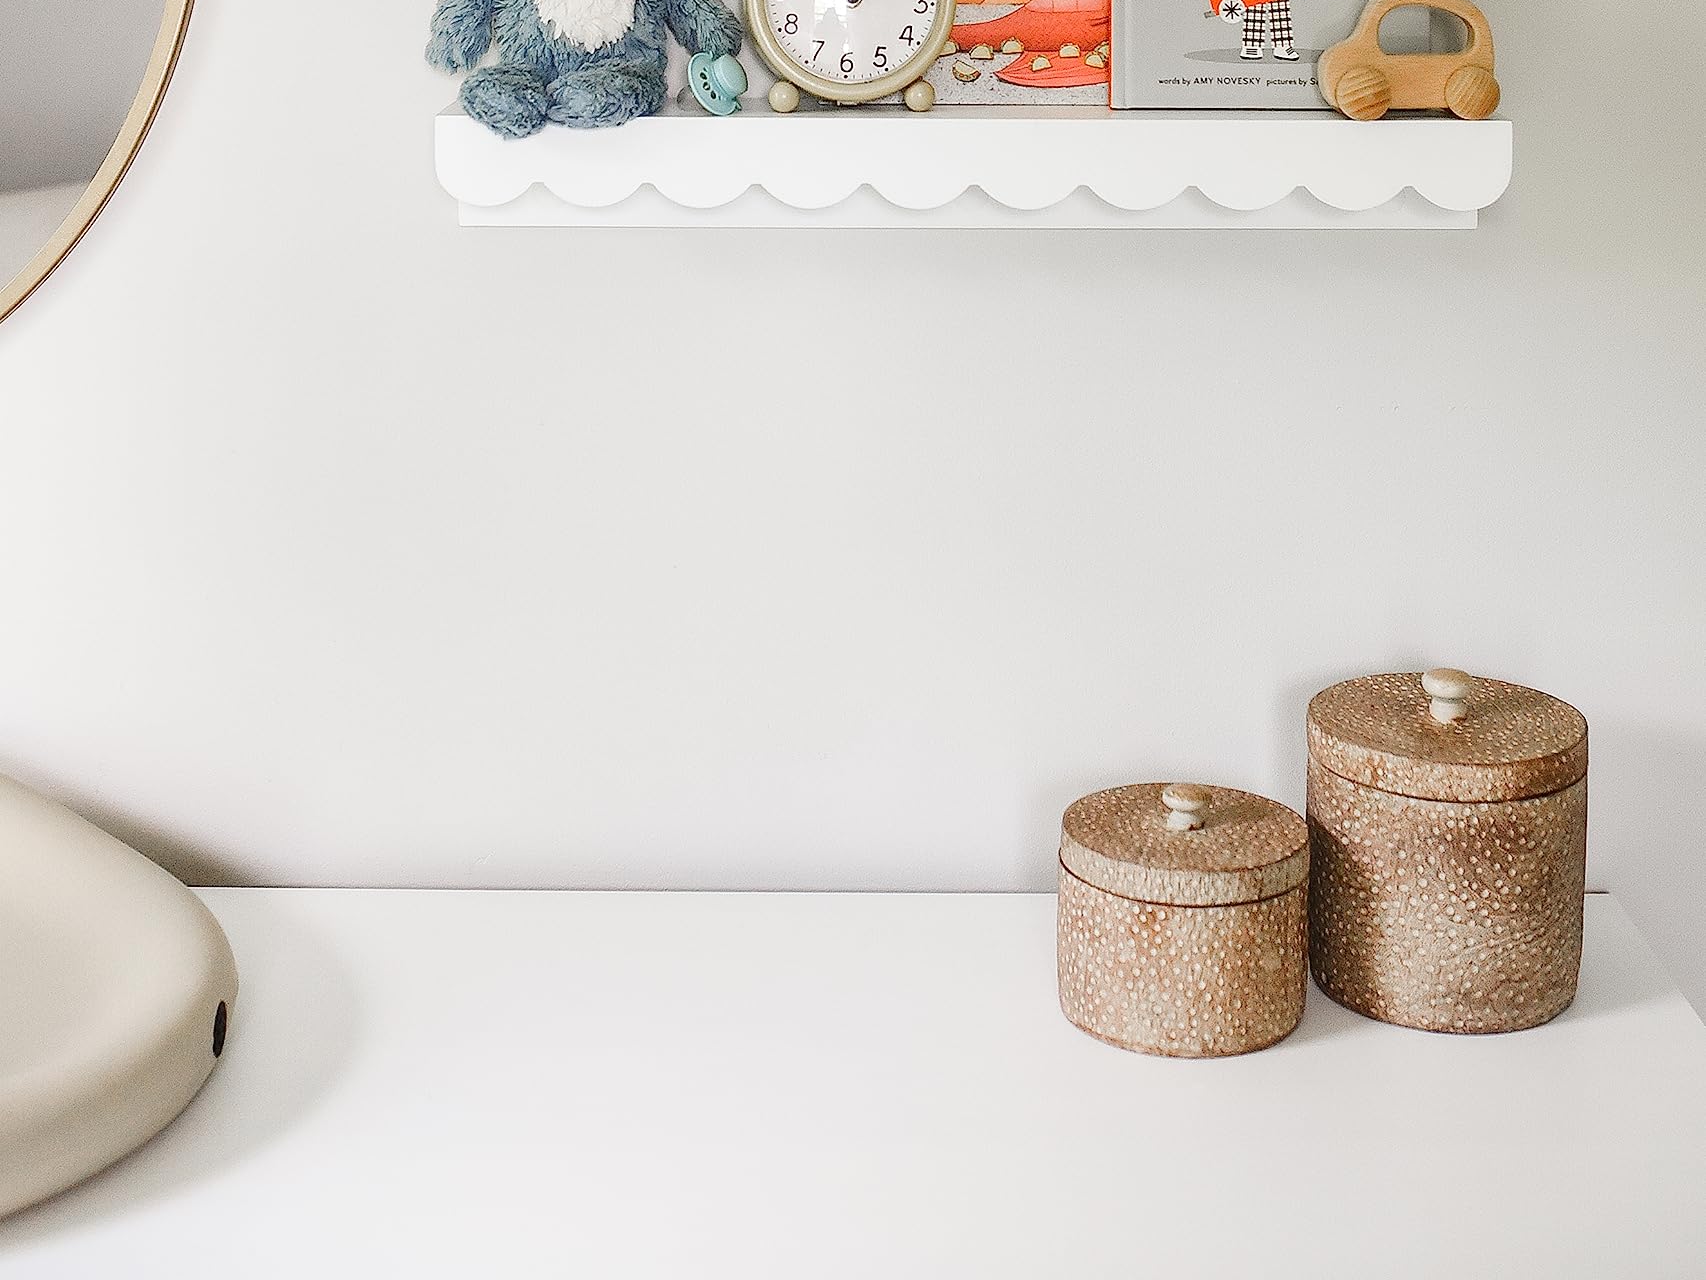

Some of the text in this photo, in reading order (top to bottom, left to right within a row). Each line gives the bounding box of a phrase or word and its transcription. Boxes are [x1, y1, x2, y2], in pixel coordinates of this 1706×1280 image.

[784, 13, 798, 35] 8
[898, 25, 915, 47] 4
[812, 39, 826, 62] 7
[873, 46, 888, 68] 5
[840, 51, 854, 74] 6
[1157, 76, 1181, 86] words
[1182, 77, 1191, 87] by
[1193, 76, 1214, 86] AMY
[1216, 76, 1262, 86] NOVESKY
[1266, 76, 1298, 87] pictures
[1299, 77, 1307, 87] by
